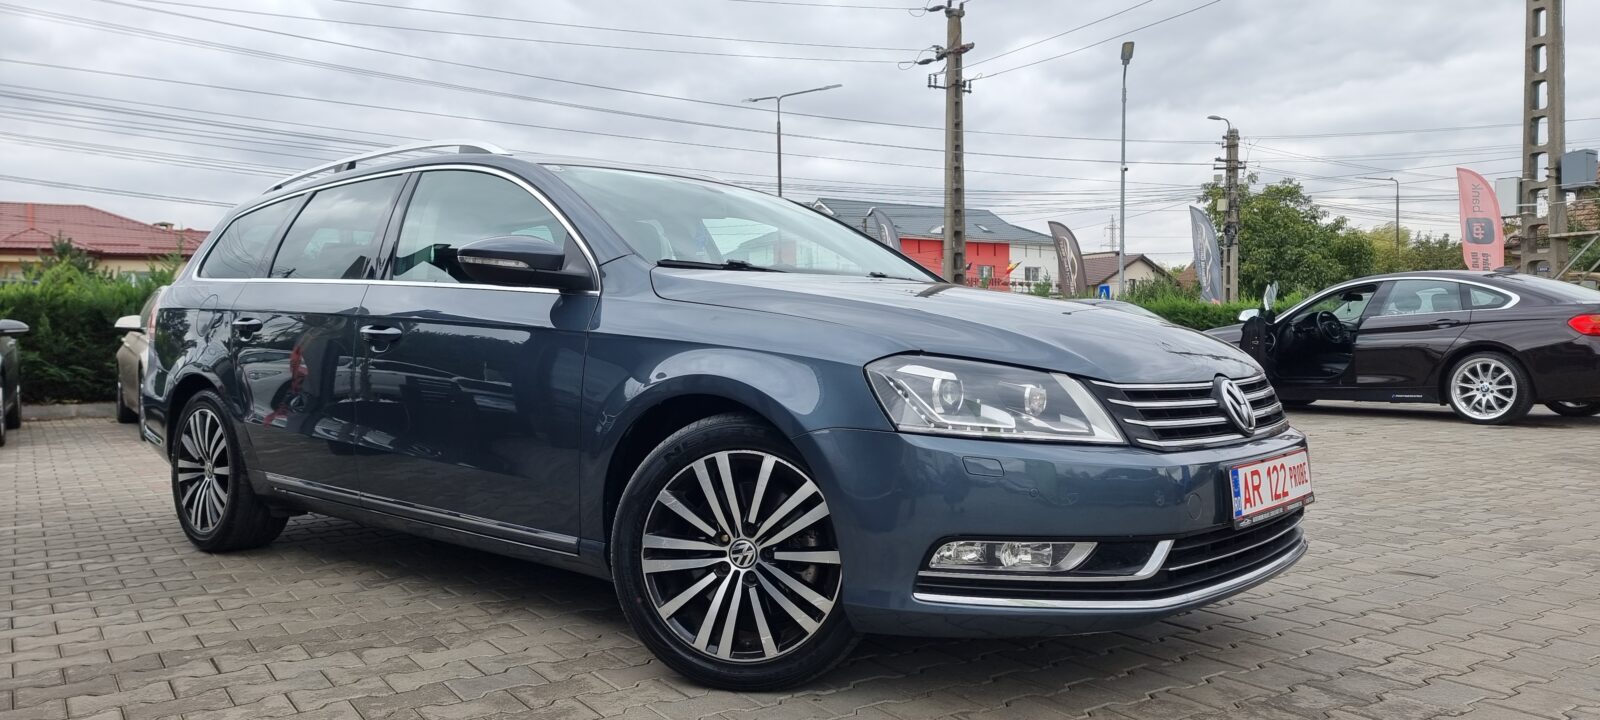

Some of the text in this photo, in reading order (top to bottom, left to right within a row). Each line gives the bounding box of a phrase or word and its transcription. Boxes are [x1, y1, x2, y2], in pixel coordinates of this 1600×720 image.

[1243, 469, 1263, 510] AR
[1266, 462, 1289, 502] 122
[1288, 462, 1308, 489] PROBE
